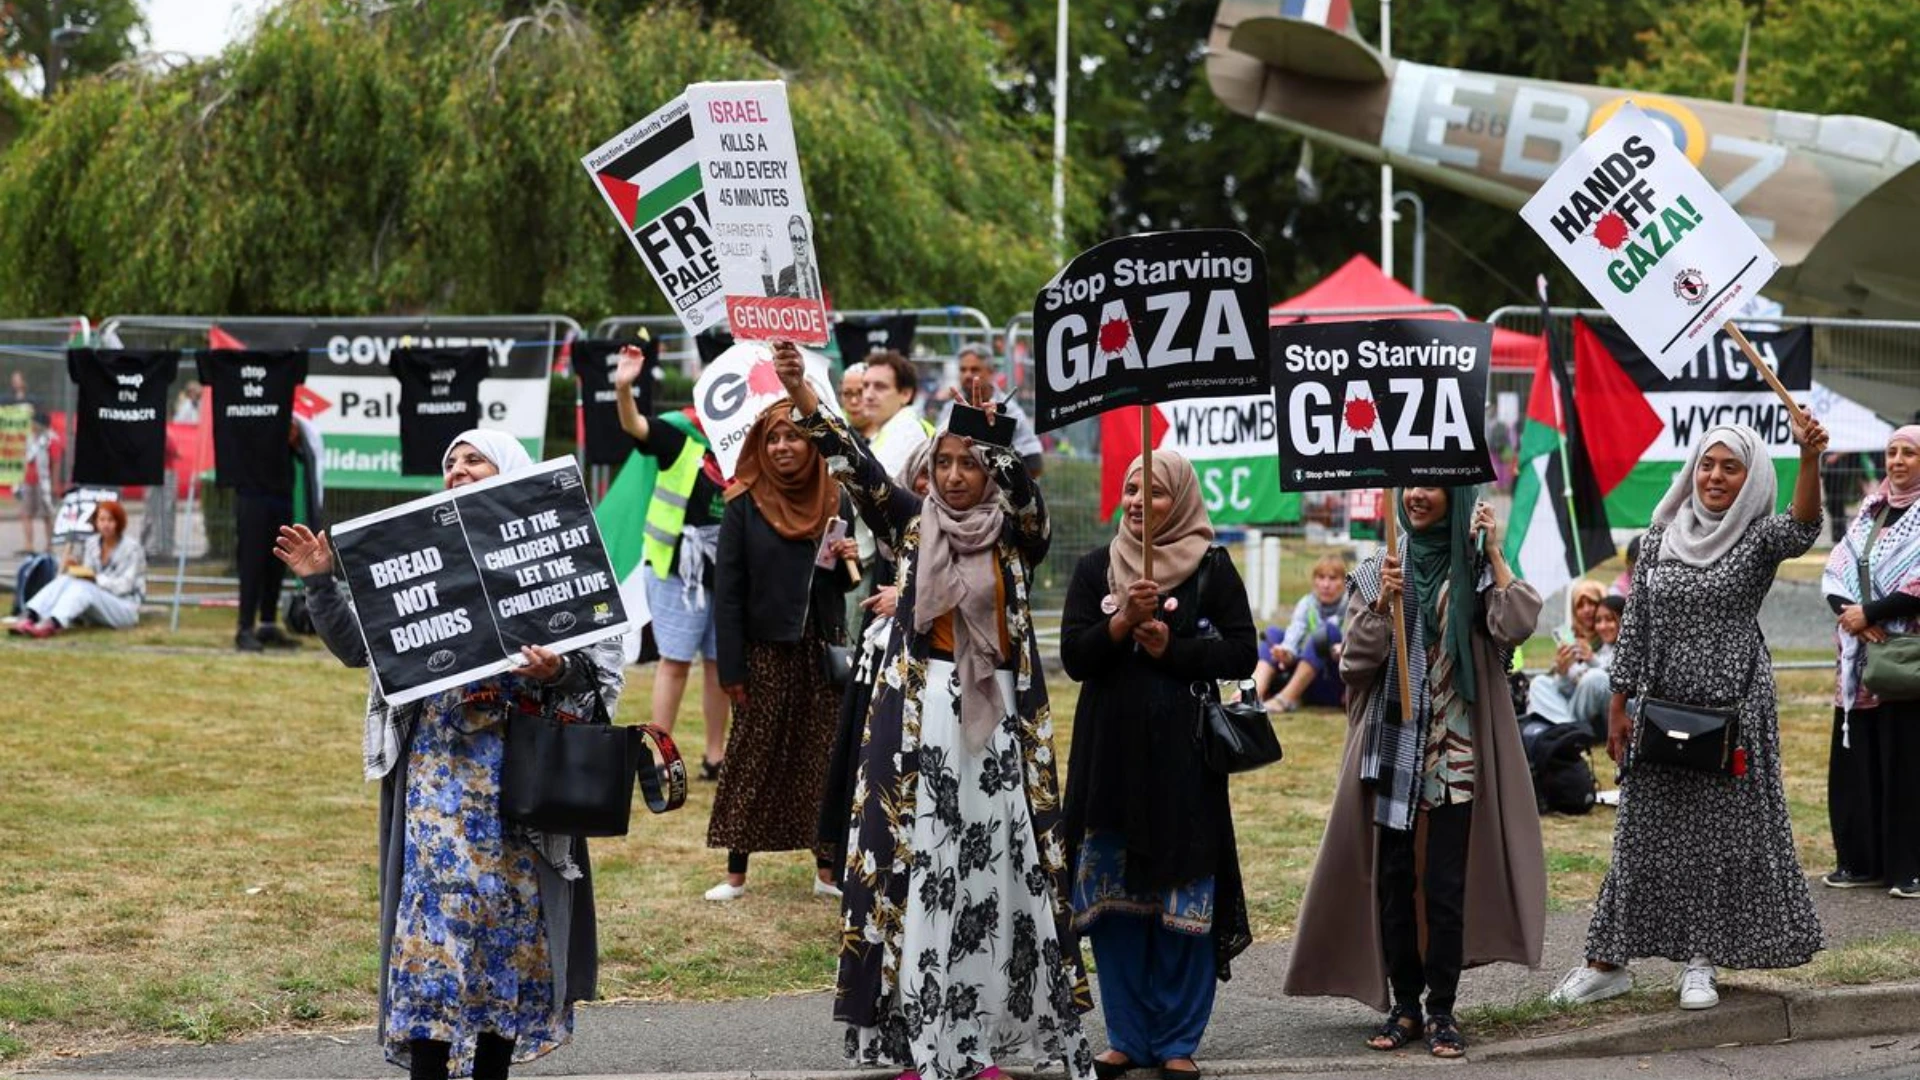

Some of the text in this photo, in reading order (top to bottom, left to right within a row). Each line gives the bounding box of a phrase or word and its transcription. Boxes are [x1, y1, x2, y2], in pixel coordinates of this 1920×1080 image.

[708, 100, 768, 123] ISRAEL
[589, 102, 690, 169] Palestine Solidarity Campai
[720, 133, 768, 152] KILLS A
[709, 160, 788, 179] CHILD EVERY
[719, 188, 790, 207] 45 MINUTES
[1550, 135, 1656, 244] HANDS
[635, 191, 712, 276] FR
[719, 242, 753, 257] CALLED
[1607, 194, 1704, 294] GAZA!
[662, 248, 720, 297] PALE
[699, 278, 722, 297] ISRA
[1045, 251, 1253, 310] Stop Starving
[734, 306, 822, 332] GENOCIDE
[1688, 284, 1742, 339] www.stopwar.org.uk
[1046, 289, 1256, 393] GAZA
[1286, 338, 1478, 376] Stop Starving
[241, 366, 267, 381] stop
[1167, 376, 1258, 389] www.stopwar.org.uk
[243, 384, 264, 398] the
[1060, 404, 1077, 415] Stop
[1077, 400, 1089, 409] the
[1089, 394, 1104, 404] War
[99, 407, 156, 421] massacre
[1289, 377, 1476, 456] GAZA
[1305, 471, 1323, 480] Stop
[1324, 470, 1336, 479] the
[1336, 469, 1352, 478] War
[1411, 465, 1483, 476] www.stopwar.org.uk
[499, 509, 561, 542] LET THE
[484, 525, 592, 571] CHILDREN EAT
[369, 546, 444, 589] BREAD
[515, 555, 577, 587] LET THE
[392, 581, 440, 618] NOT
[498, 581, 574, 619] CHILDREN
[576, 571, 610, 597] LIVE
[390, 607, 473, 654] BOMBS
